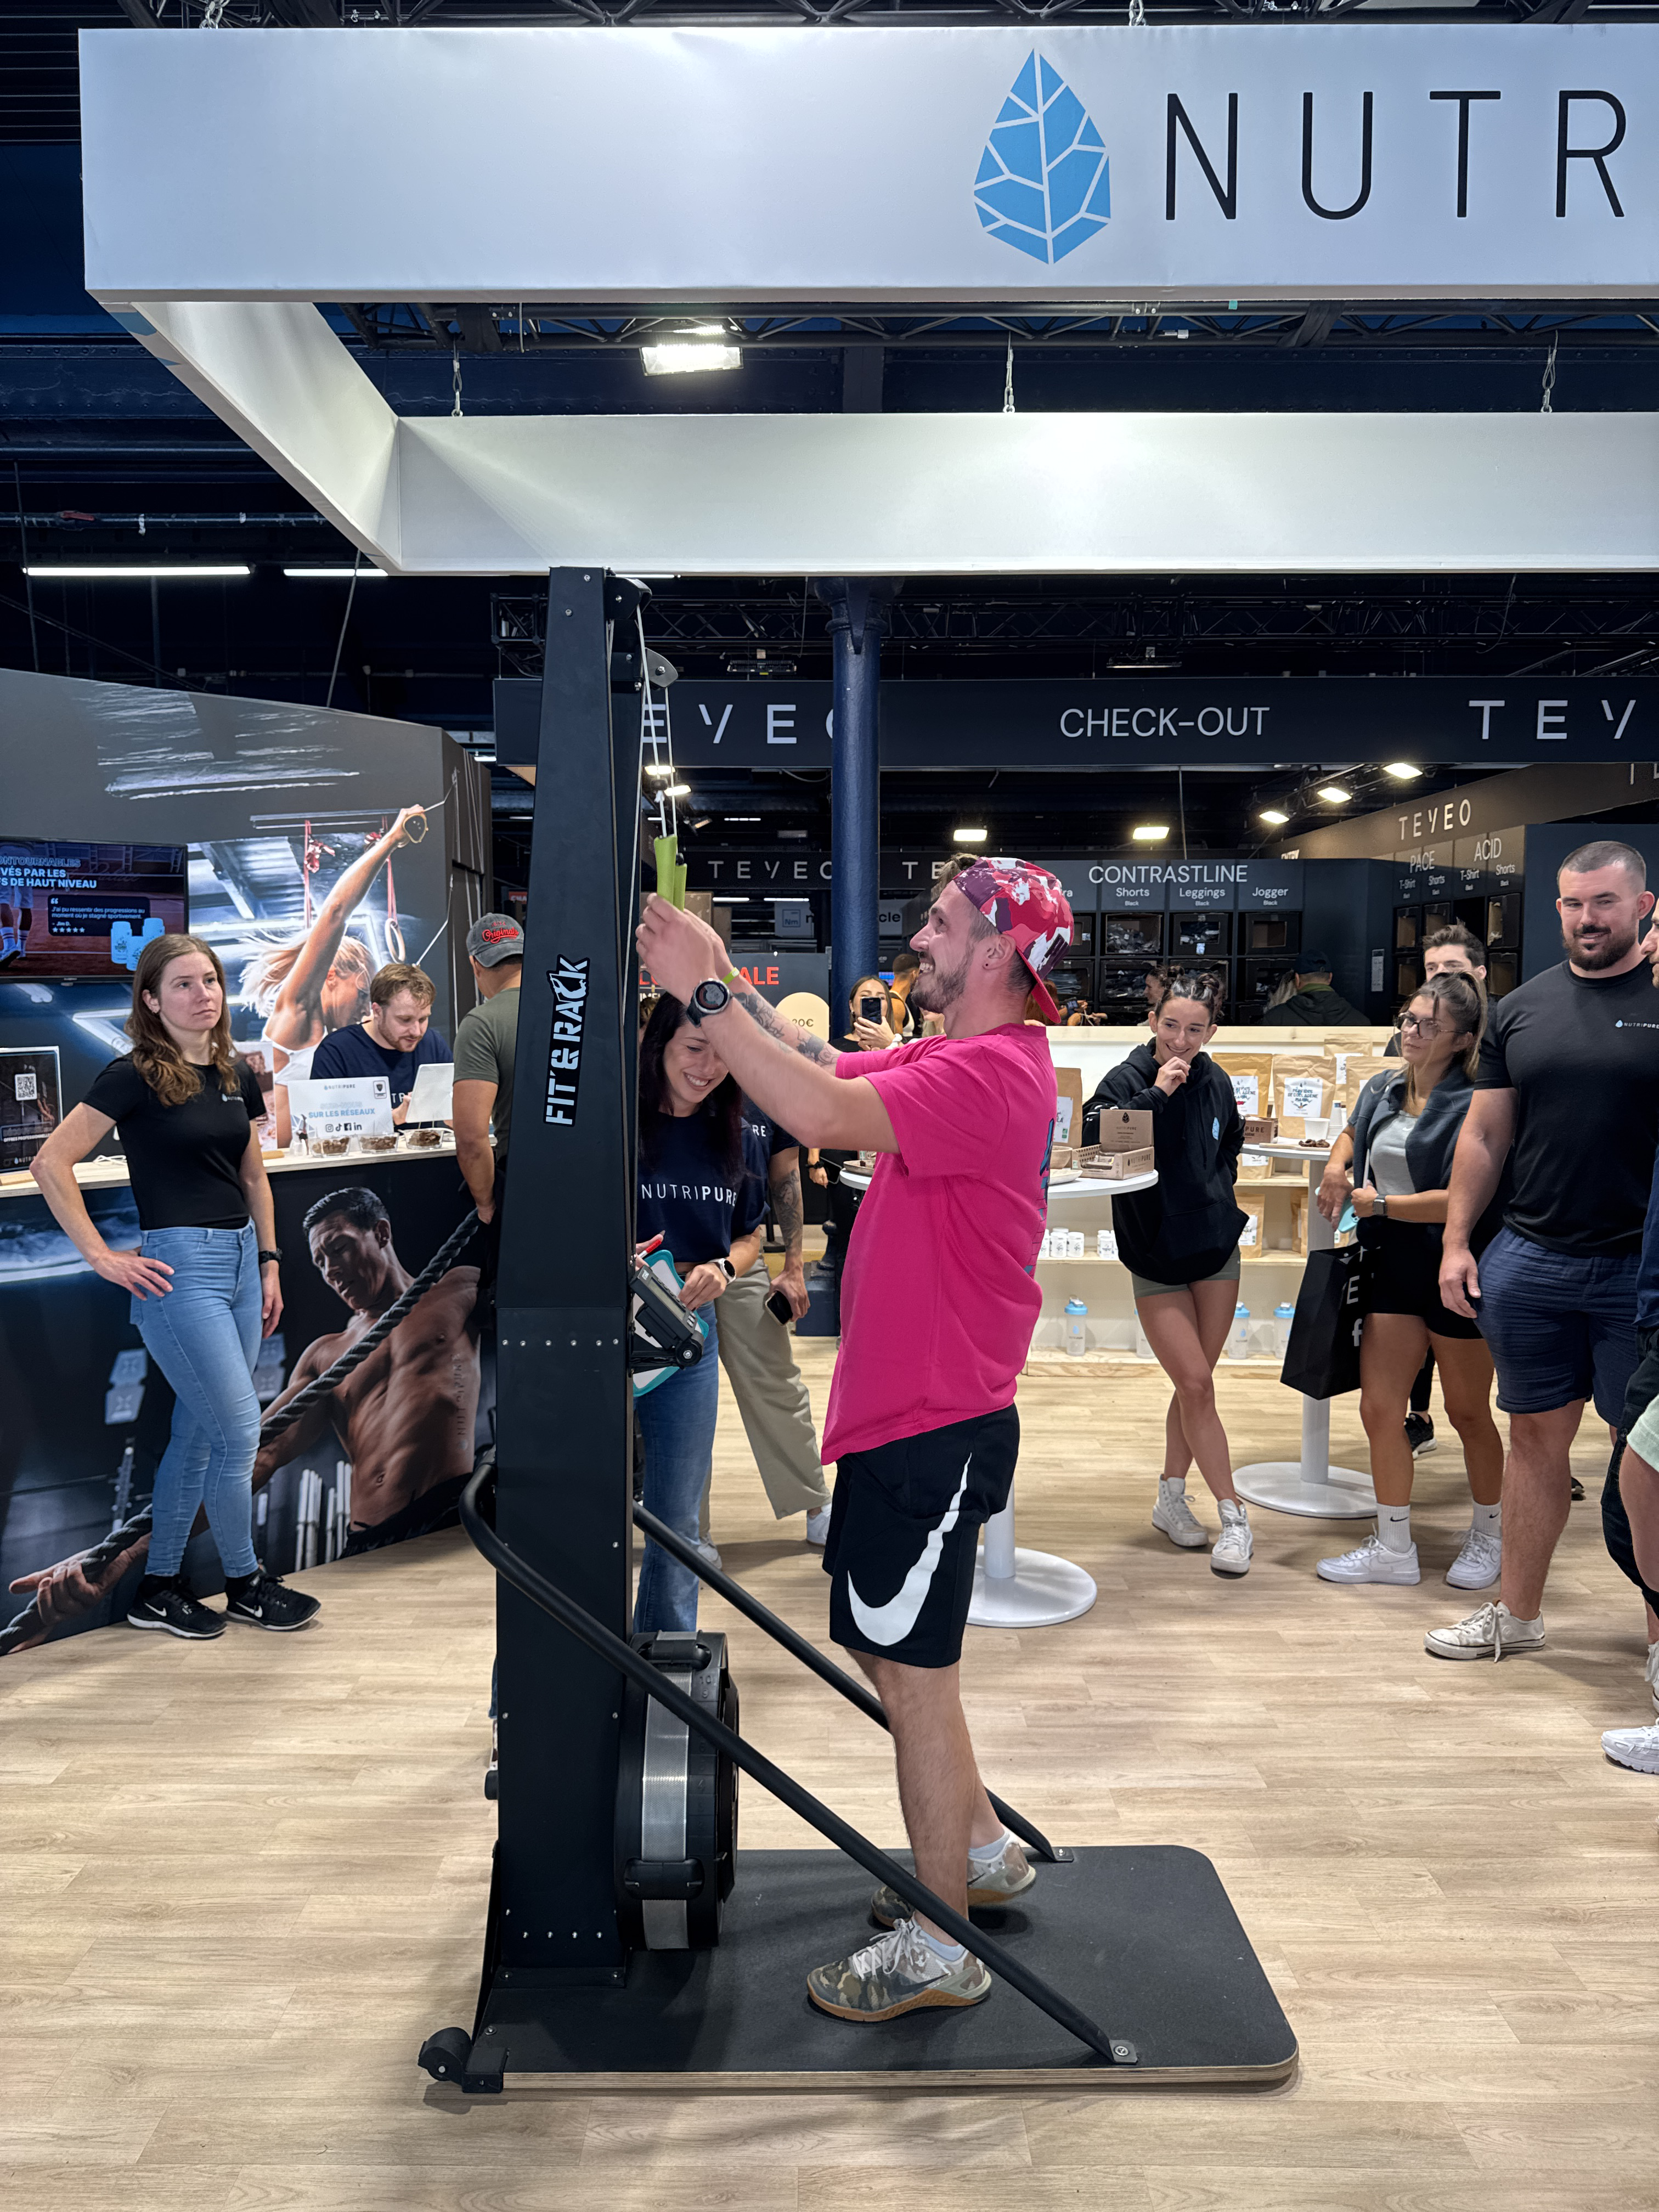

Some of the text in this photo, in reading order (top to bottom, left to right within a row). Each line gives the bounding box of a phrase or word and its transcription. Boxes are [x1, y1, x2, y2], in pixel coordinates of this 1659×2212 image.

[1166, 91, 1626, 219] NUTR
[642, 704, 833, 744] EVE
[1060, 707, 1270, 738] CHECK-OUT
[1398, 799, 1471, 840] TEVEO
[1473, 837, 1502, 862] ACID
[0, 855, 81, 867] NTOURNABLES
[1409, 850, 1435, 873] PACE
[0, 865, 22, 876] VÉS
[24, 868, 46, 877] PAR
[47, 869, 66, 878] LES
[1088, 865, 1248, 884] CONTRASTLINE
[1460, 868, 1480, 881] T-Shirt
[1496, 863, 1515, 876] Shorts
[10, 878, 25, 887] DE
[26, 878, 57, 888] HAUT
[58, 879, 97, 889] NIVEAU
[1399, 878, 1416, 890] T-Shirt
[1428, 874, 1446, 886] Shorts
[1116, 887, 1150, 897] Shorts
[1180, 887, 1226, 899] Leggings
[1252, 887, 1289, 899] Jogger
[341, 1108, 375, 1116] RÉSEAUX
[641, 1183, 737, 1207] NUTRIPURE
